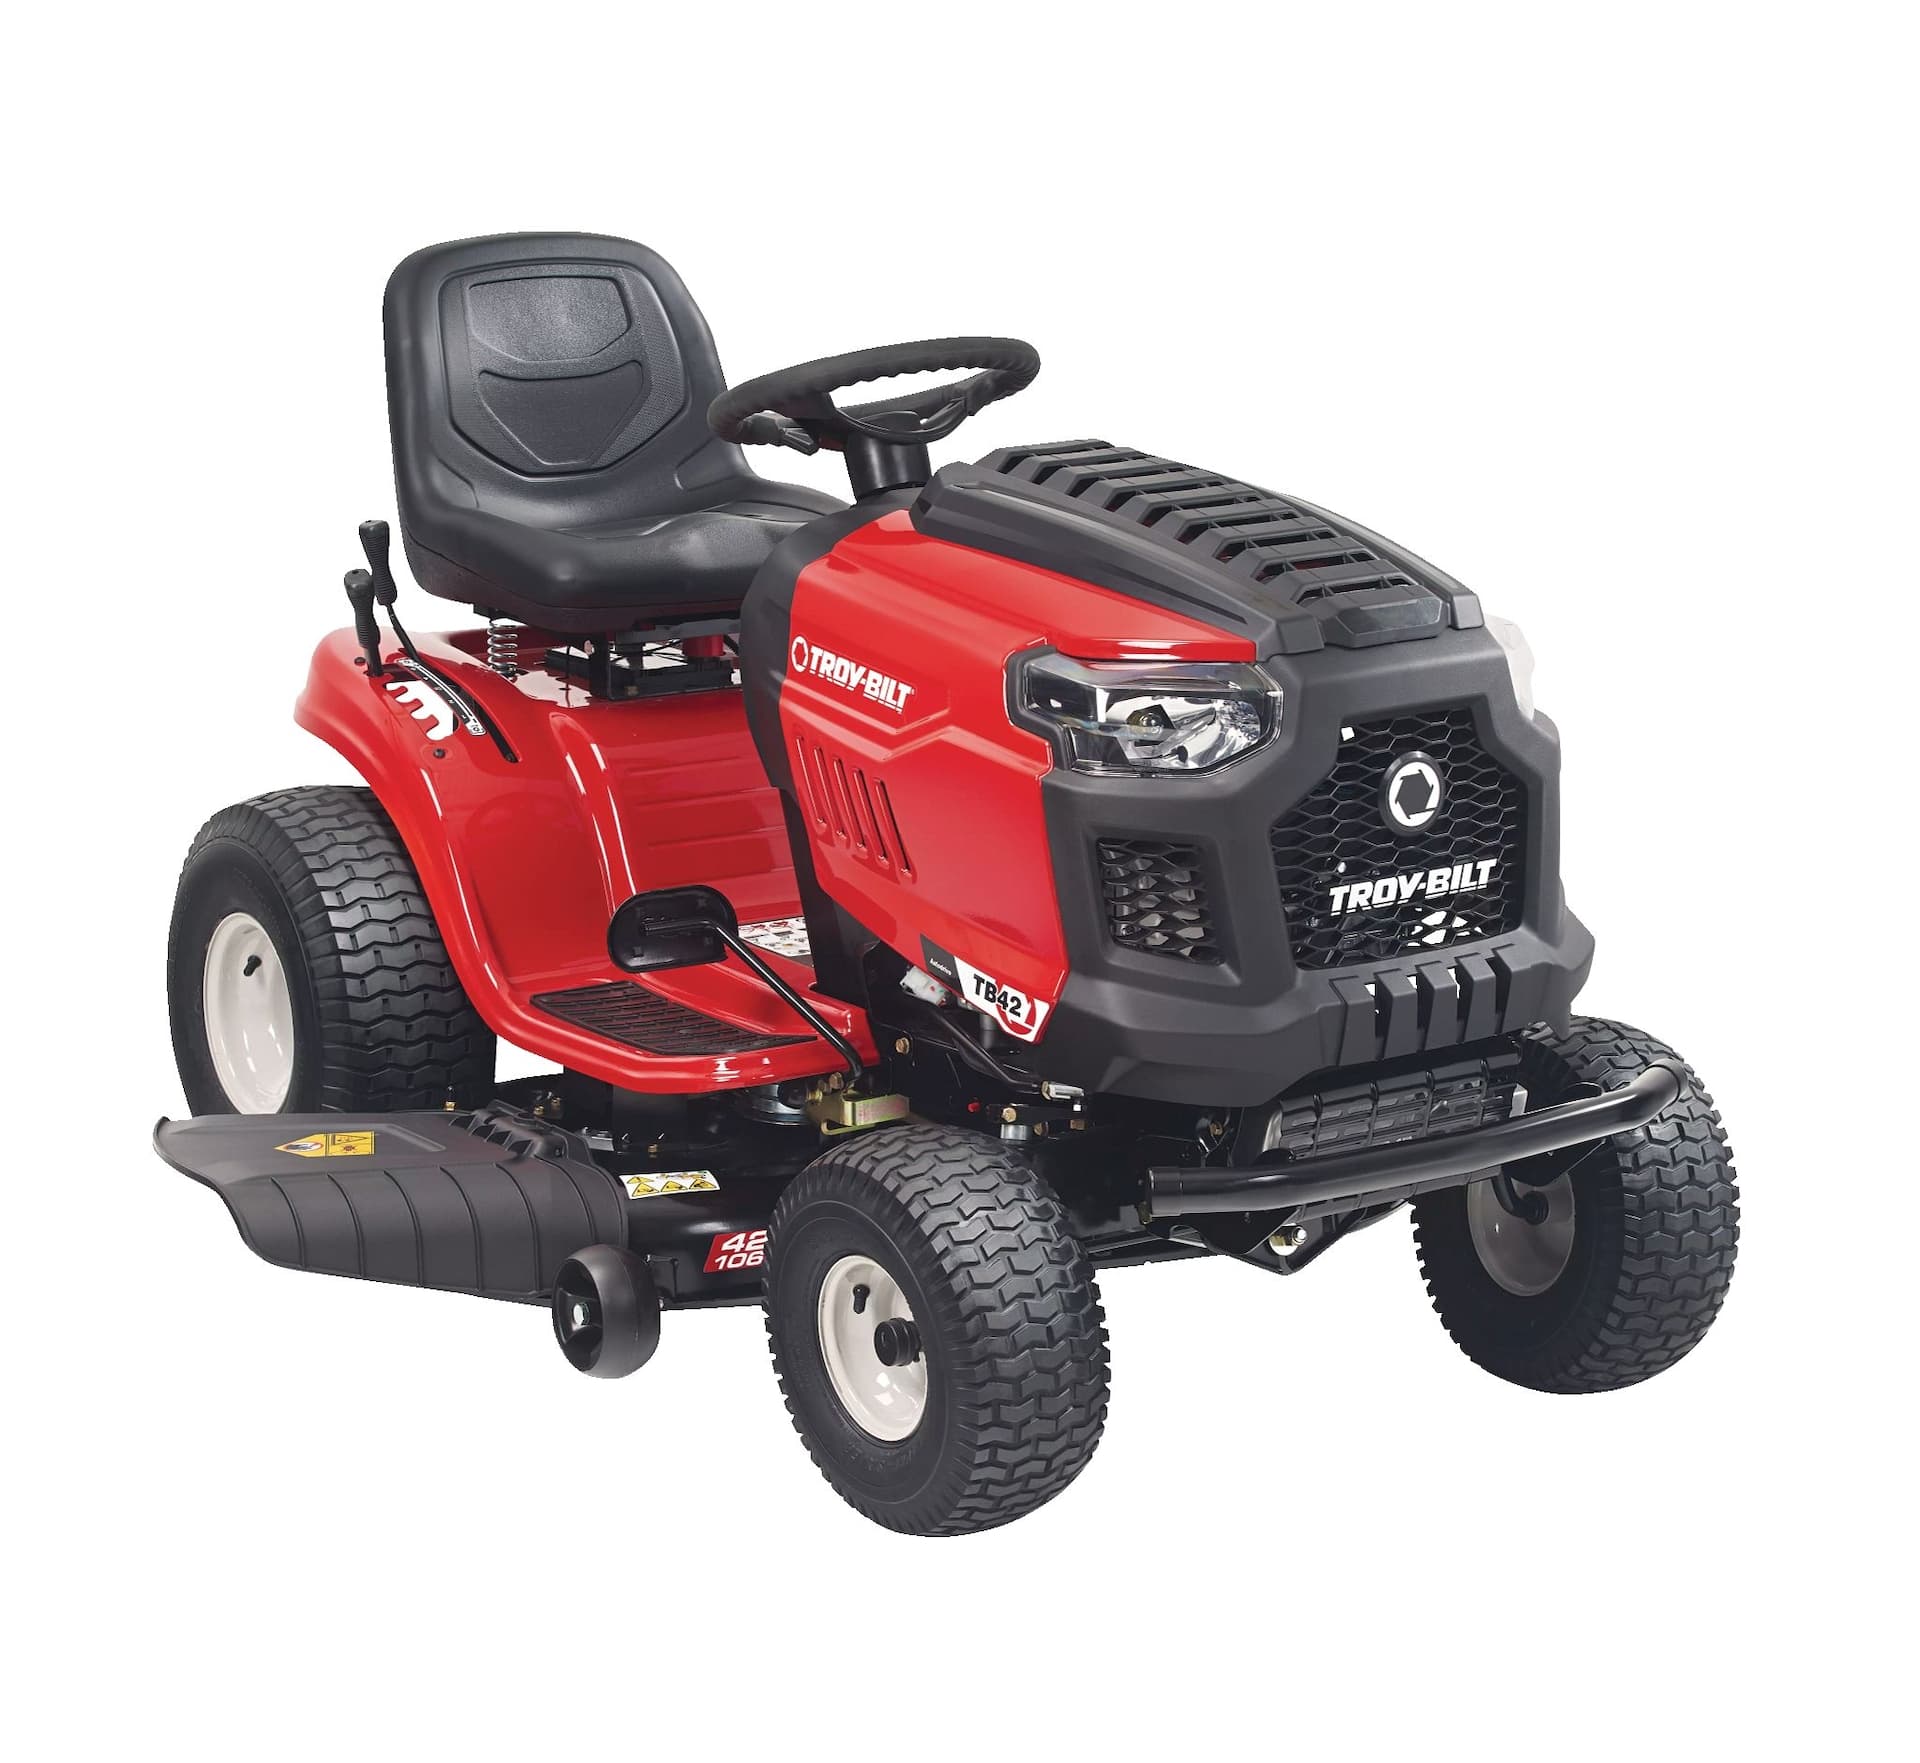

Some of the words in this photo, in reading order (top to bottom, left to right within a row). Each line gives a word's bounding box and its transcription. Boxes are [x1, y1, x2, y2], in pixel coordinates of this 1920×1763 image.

[809, 645, 912, 714] TROY-BILT
[1329, 859, 1497, 916] TROY-BILT
[973, 973, 1022, 1018] TB42
[715, 1251, 764, 1269] 106
[721, 1230, 768, 1252] 42
